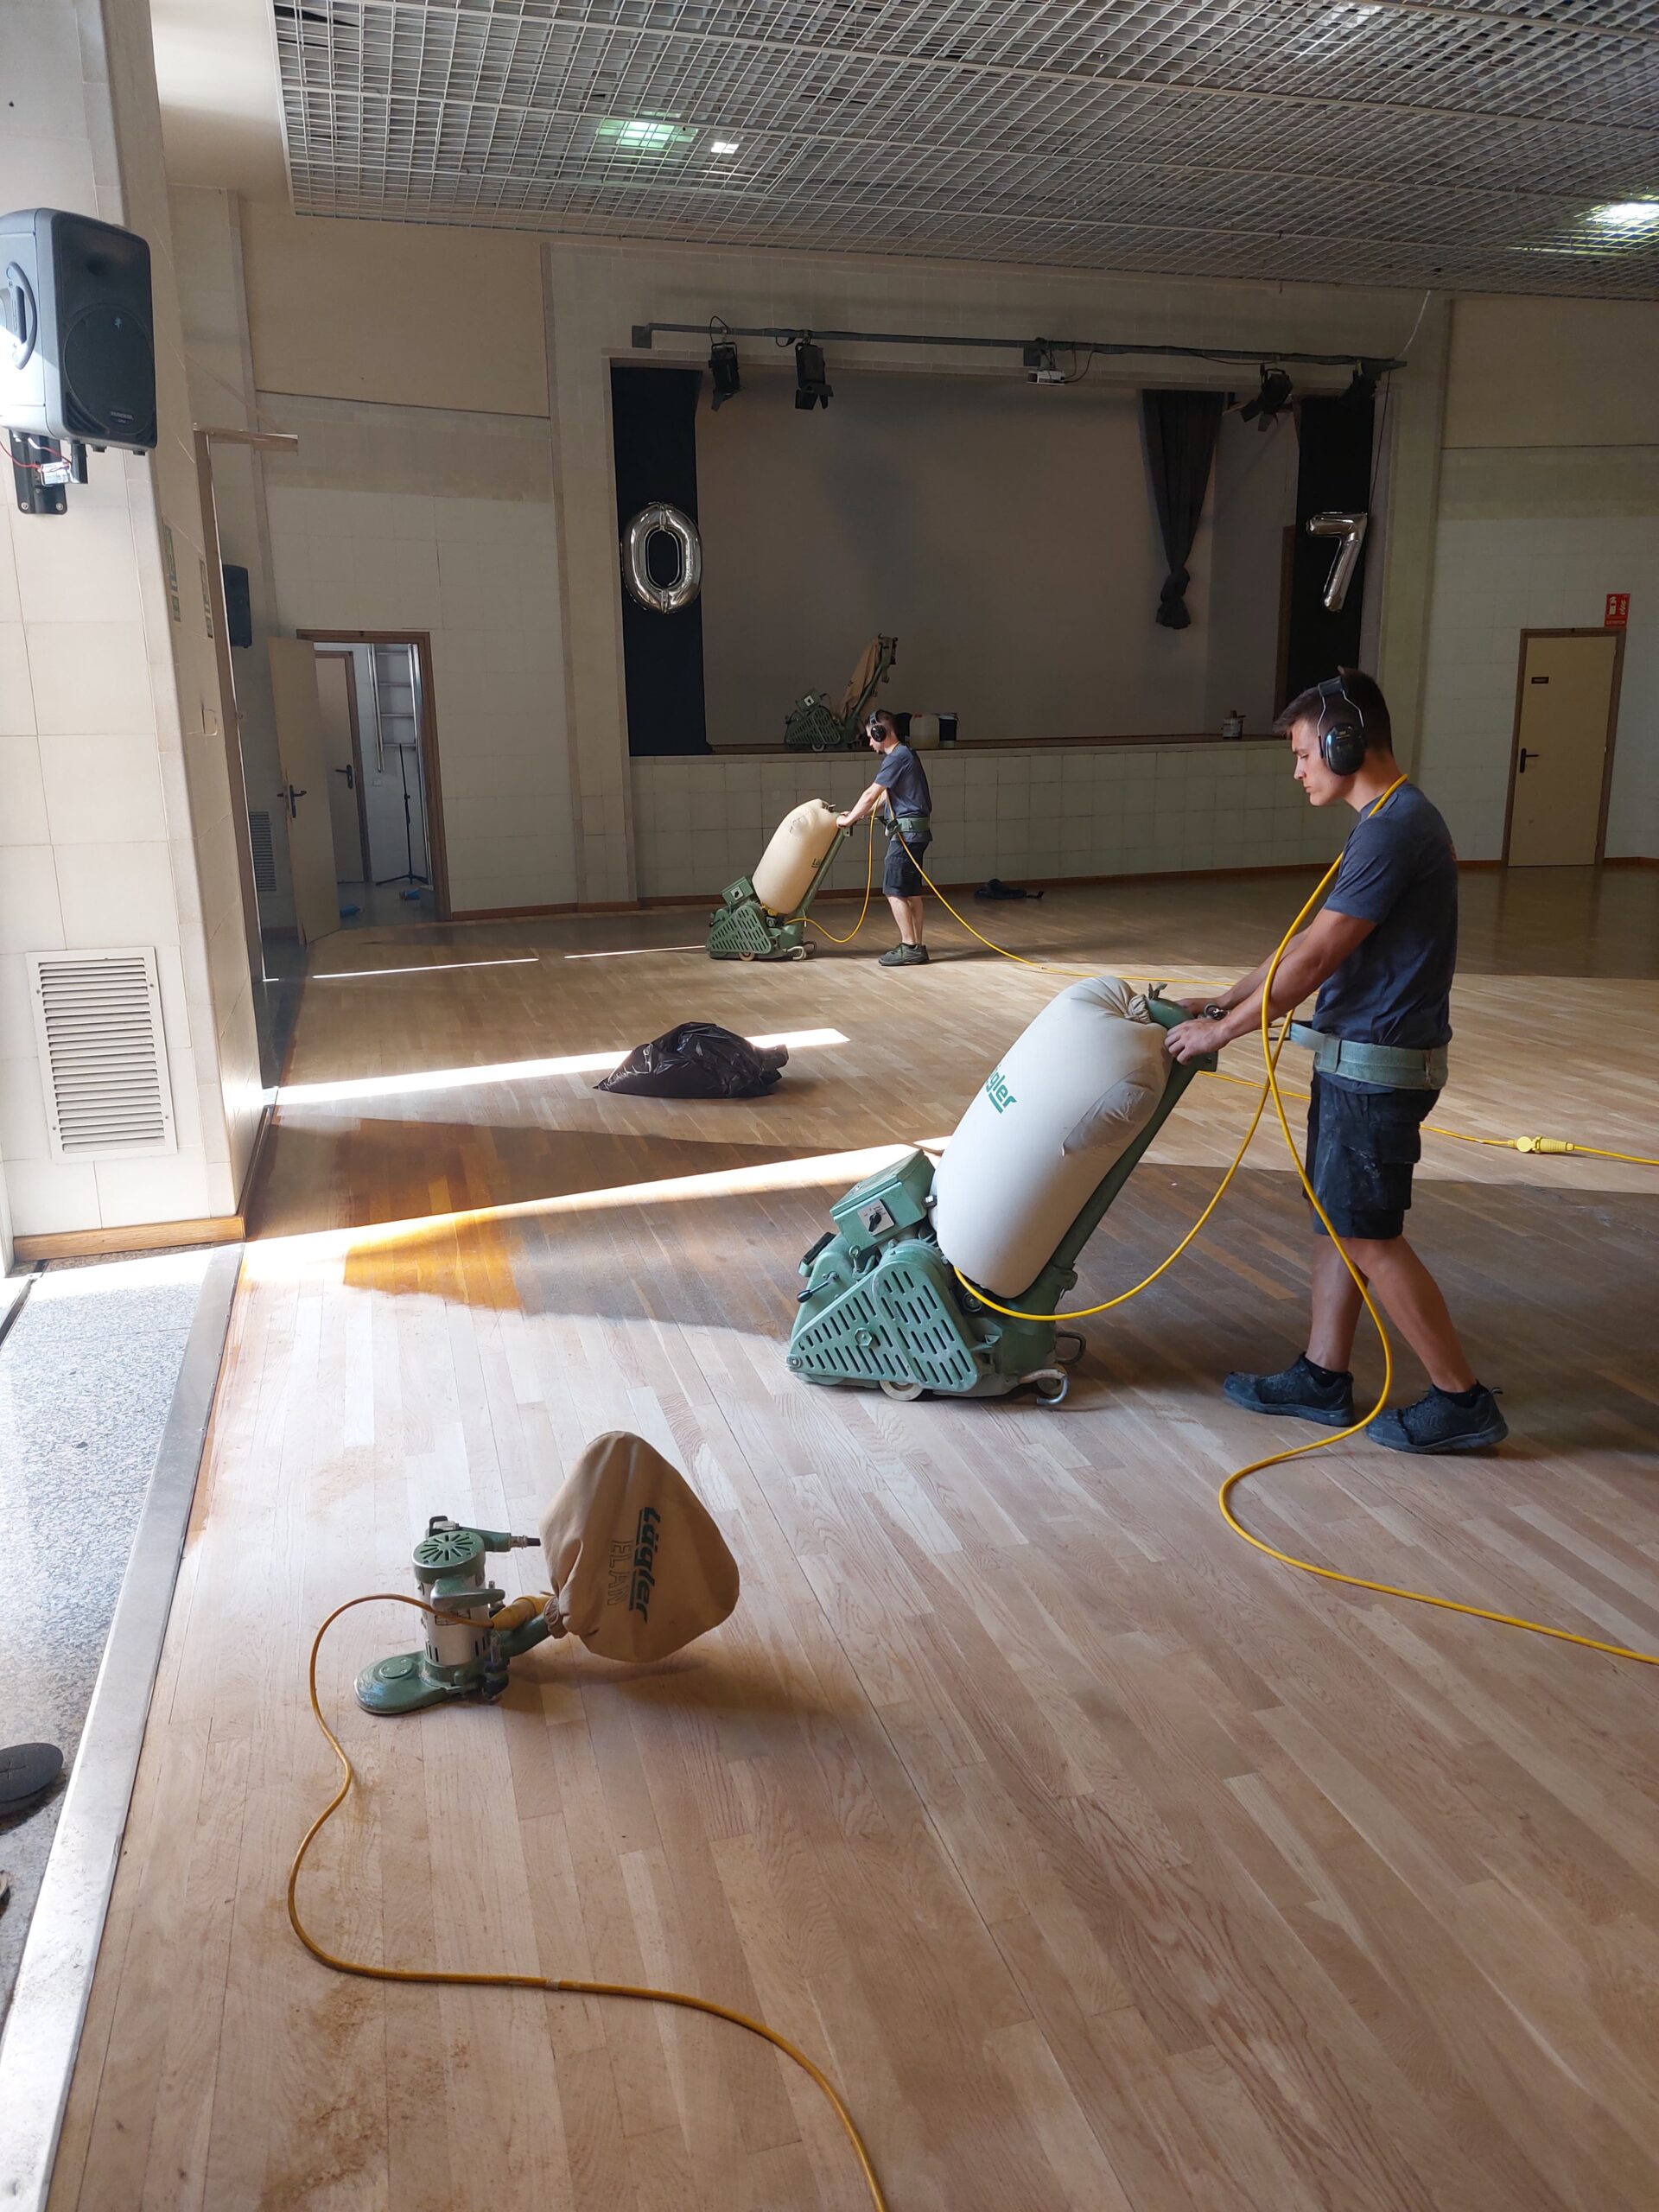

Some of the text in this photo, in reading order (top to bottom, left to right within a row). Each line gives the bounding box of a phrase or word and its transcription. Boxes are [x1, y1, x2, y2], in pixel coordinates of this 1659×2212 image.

[1306, 512, 1368, 612] 7
[983, 1064, 1017, 1114] gler
[607, 1539, 634, 1606] ELAN
[629, 1506, 661, 1624] Lägler
